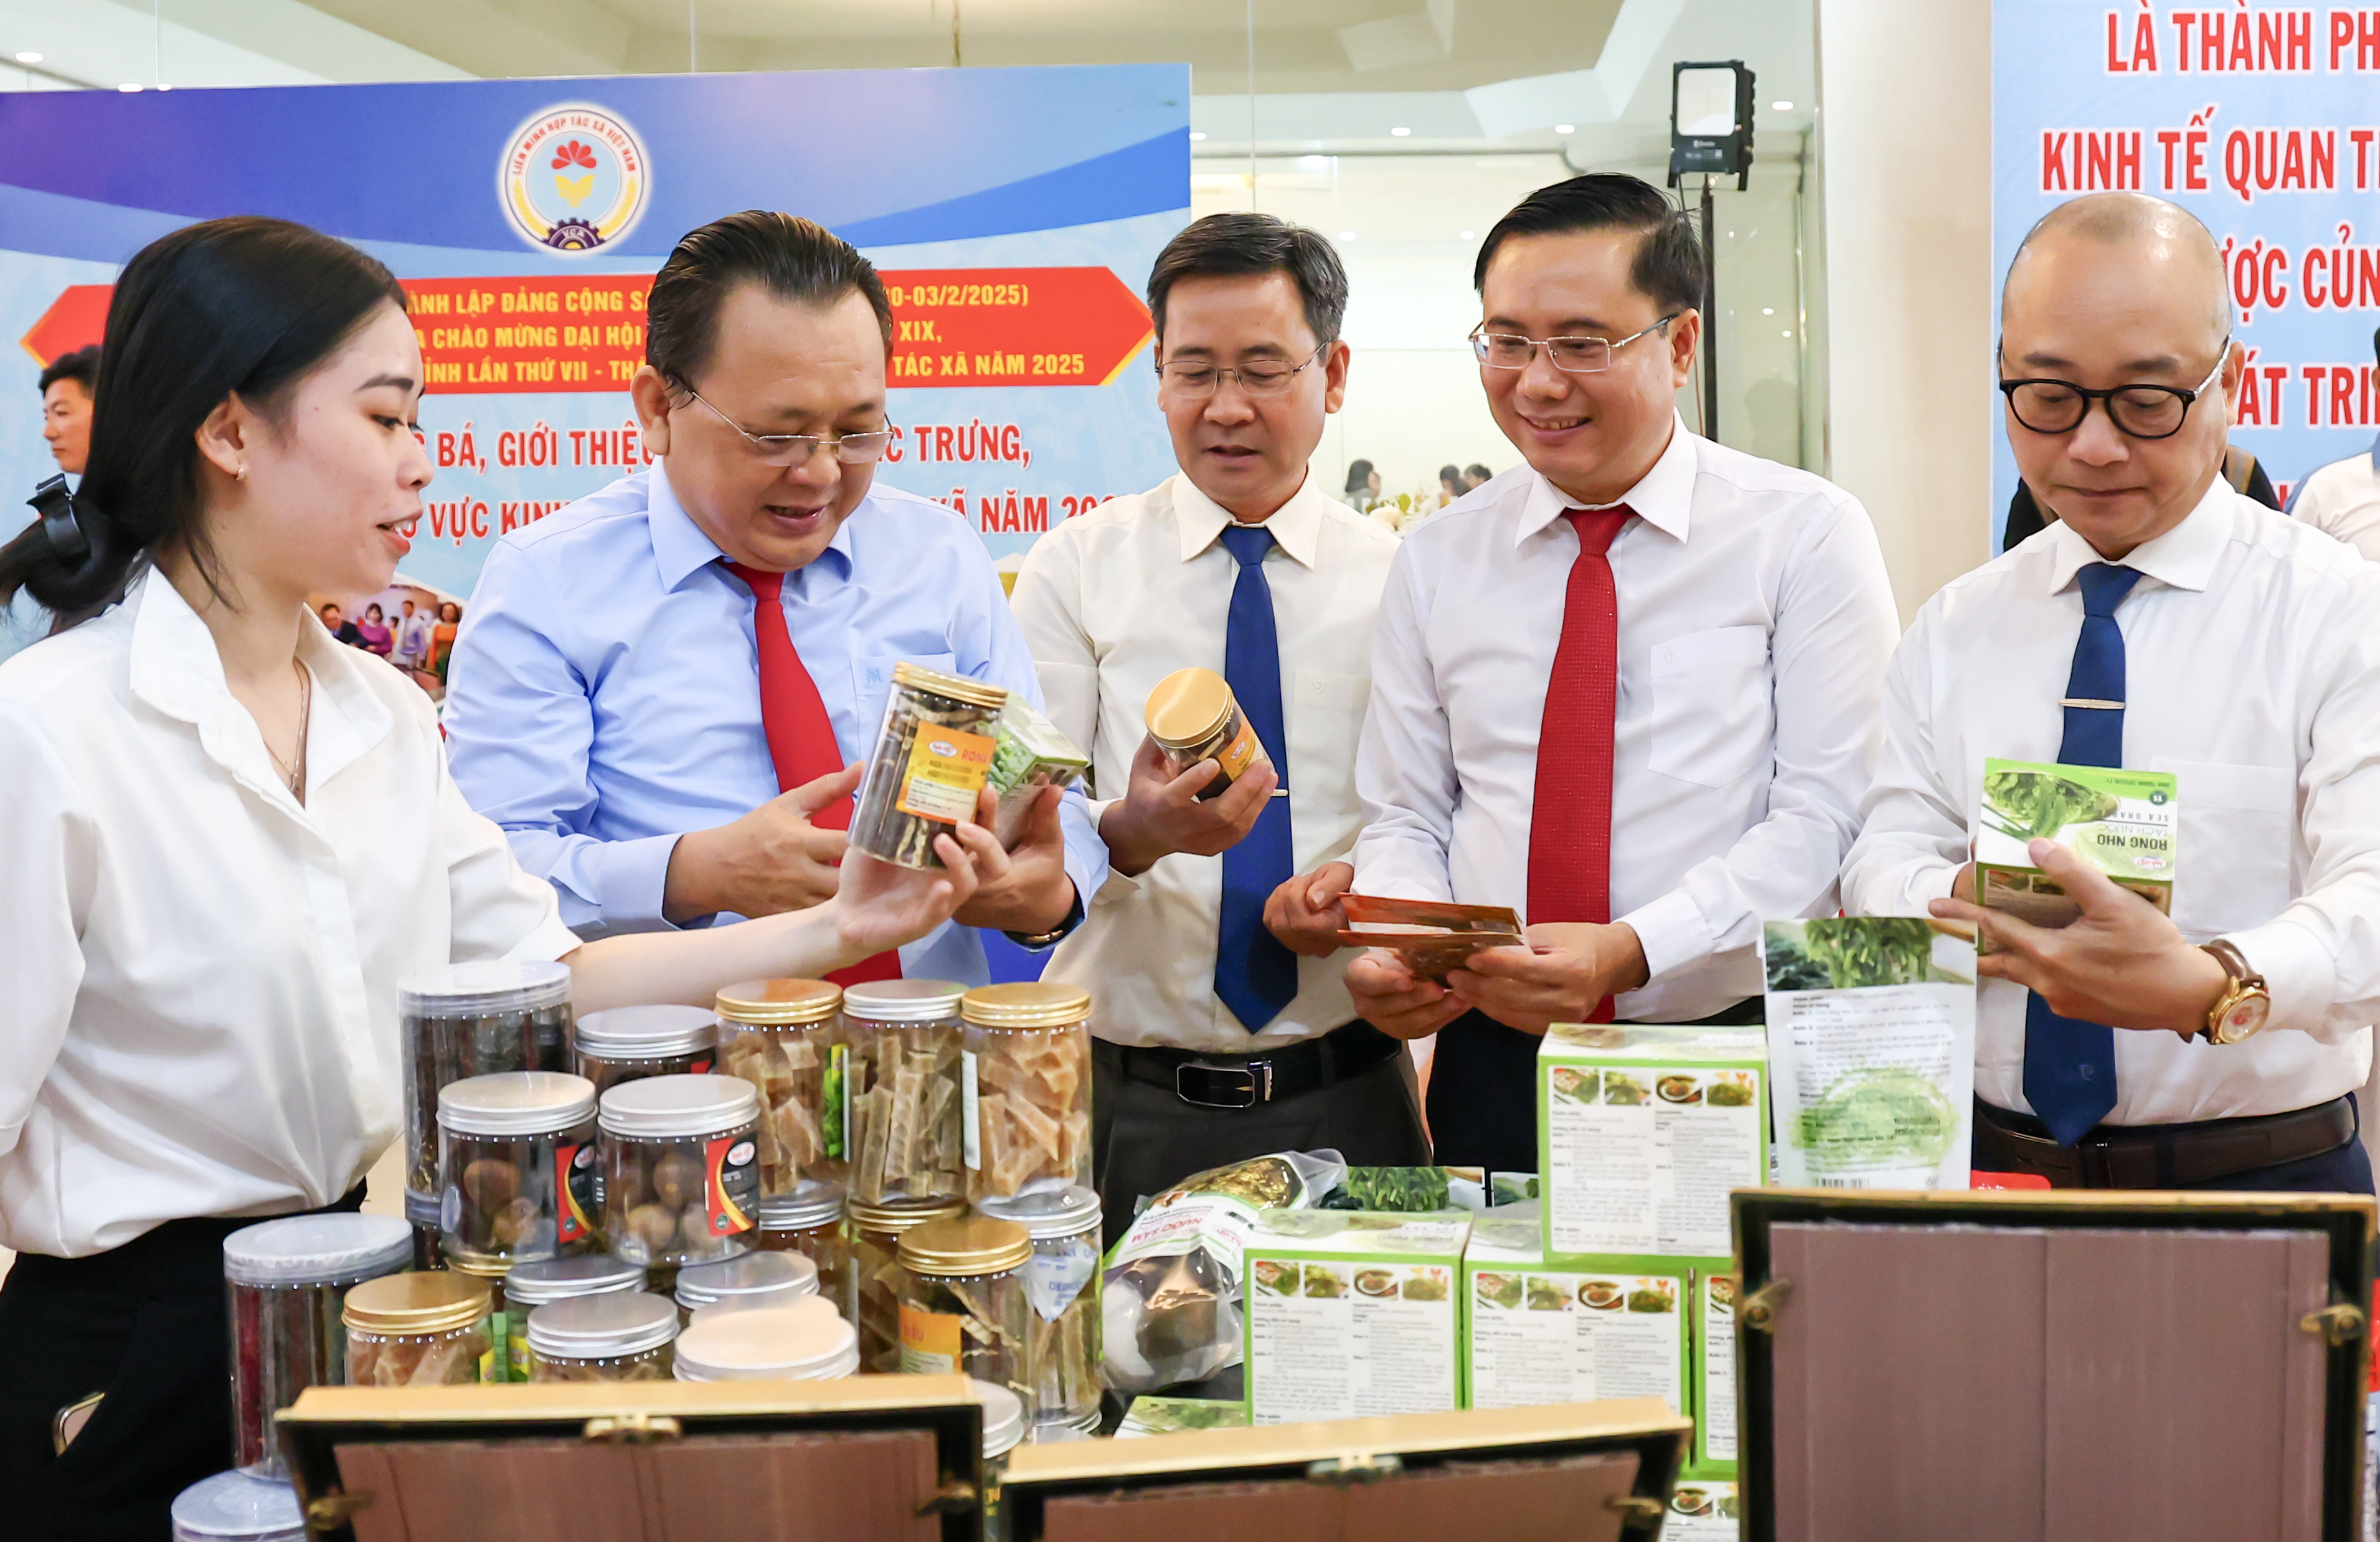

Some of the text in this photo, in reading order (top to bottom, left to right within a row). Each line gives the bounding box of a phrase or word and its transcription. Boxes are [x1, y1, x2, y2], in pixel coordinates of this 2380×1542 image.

[2108, 0, 2157, 72] LÀ
[2173, 0, 2311, 72] THÀNH
[2043, 106, 2380, 201] KINH TẾ QUAN T
[406, 290, 450, 315] ÀNH
[455, 288, 496, 318] LẬP
[501, 285, 559, 313] ĐẢNG
[564, 286, 624, 317] CỘNG
[888, 284, 1029, 308] 0-03/2/2025)
[432, 323, 489, 350] CHÀO
[494, 322, 558, 348] MỪNG
[606, 321, 641, 351] HỘI
[899, 320, 943, 344] XIX,
[424, 356, 461, 383] ỈNH
[468, 355, 509, 382] LẦN
[514, 356, 556, 382] THỨ
[560, 360, 588, 381] VII
[893, 351, 933, 377] TÁC
[940, 351, 969, 376] XÃ
[975, 350, 1026, 376] NĂM
[1032, 353, 1085, 375] 2025
[2237, 350, 2380, 425] ÁT TRI
[437, 422, 488, 475] BÁ,
[497, 419, 558, 467] GIỚI
[914, 418, 1033, 469] TRƯNG,
[428, 496, 489, 547] VỰC
[501, 502, 571, 535] KIN
[981, 488, 1050, 533] NĂM
[2097, 834, 2168, 851] RONG NHO
